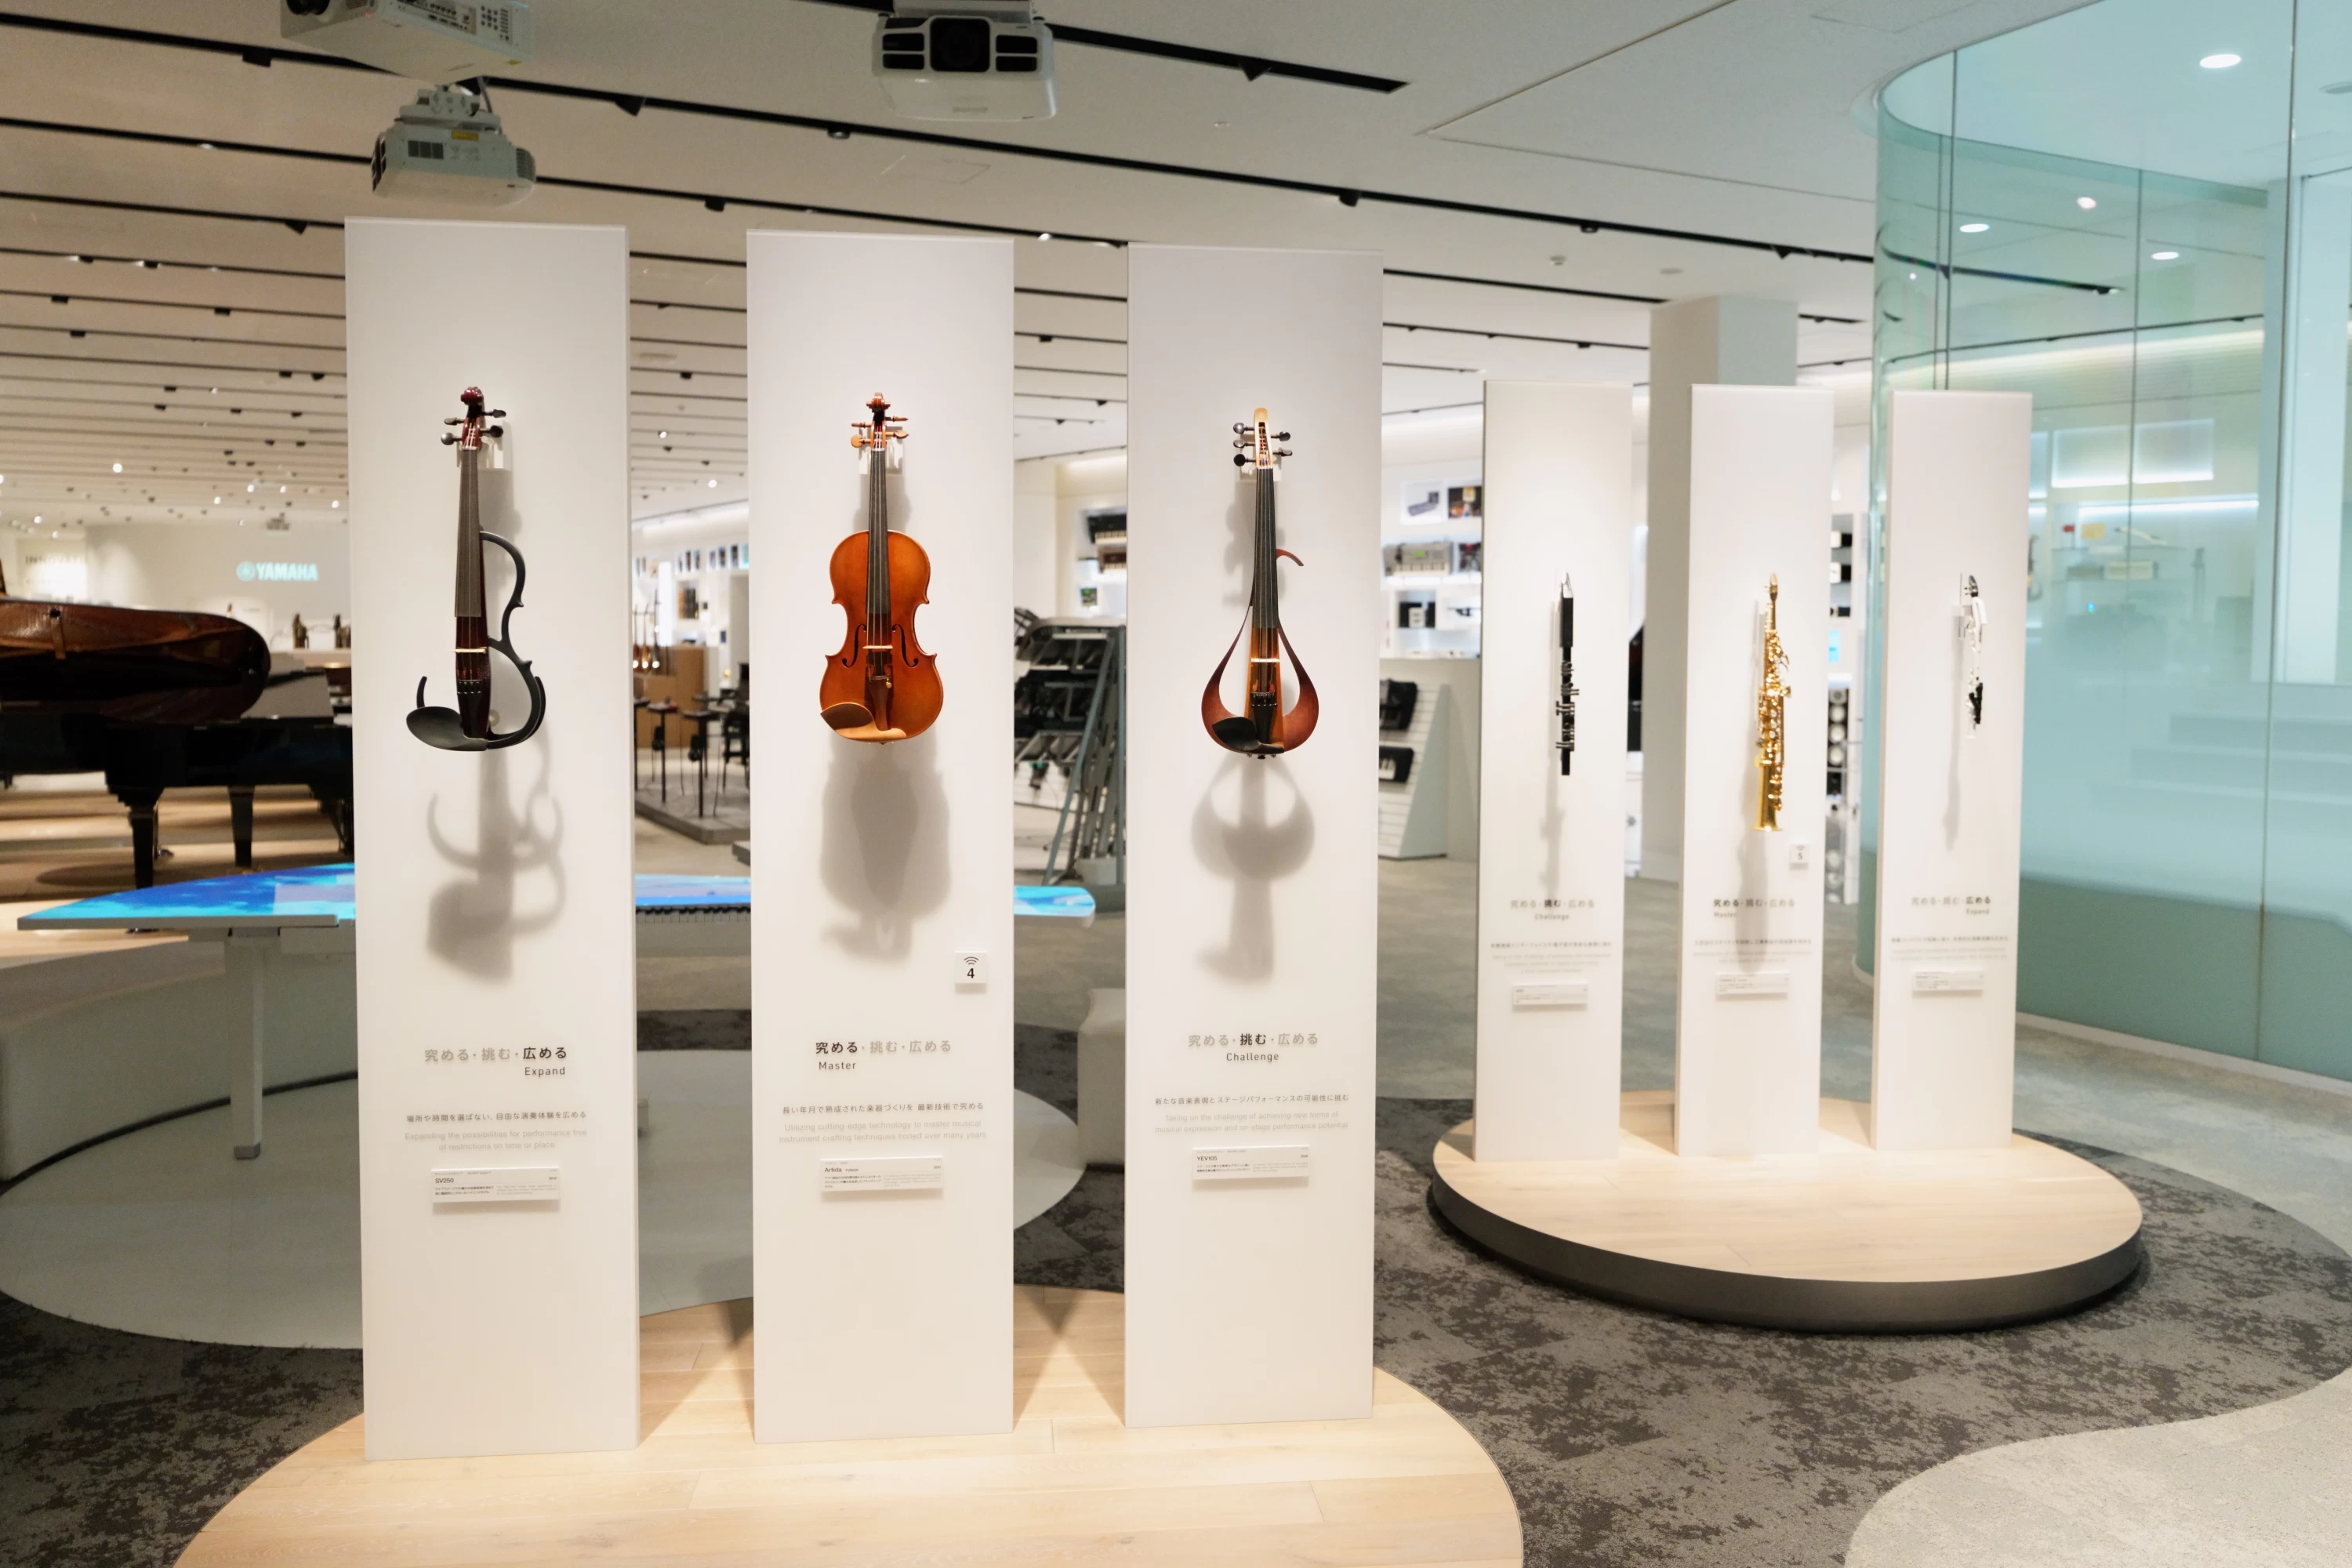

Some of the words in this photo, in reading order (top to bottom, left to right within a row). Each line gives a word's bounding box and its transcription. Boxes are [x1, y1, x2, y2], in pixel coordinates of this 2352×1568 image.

[256, 562, 319, 581] YAMAHA
[967, 968, 975, 978] 4
[1226, 1053, 1279, 1062] Challenge
[819, 1061, 856, 1069] Master
[524, 1066, 565, 1077] Expand
